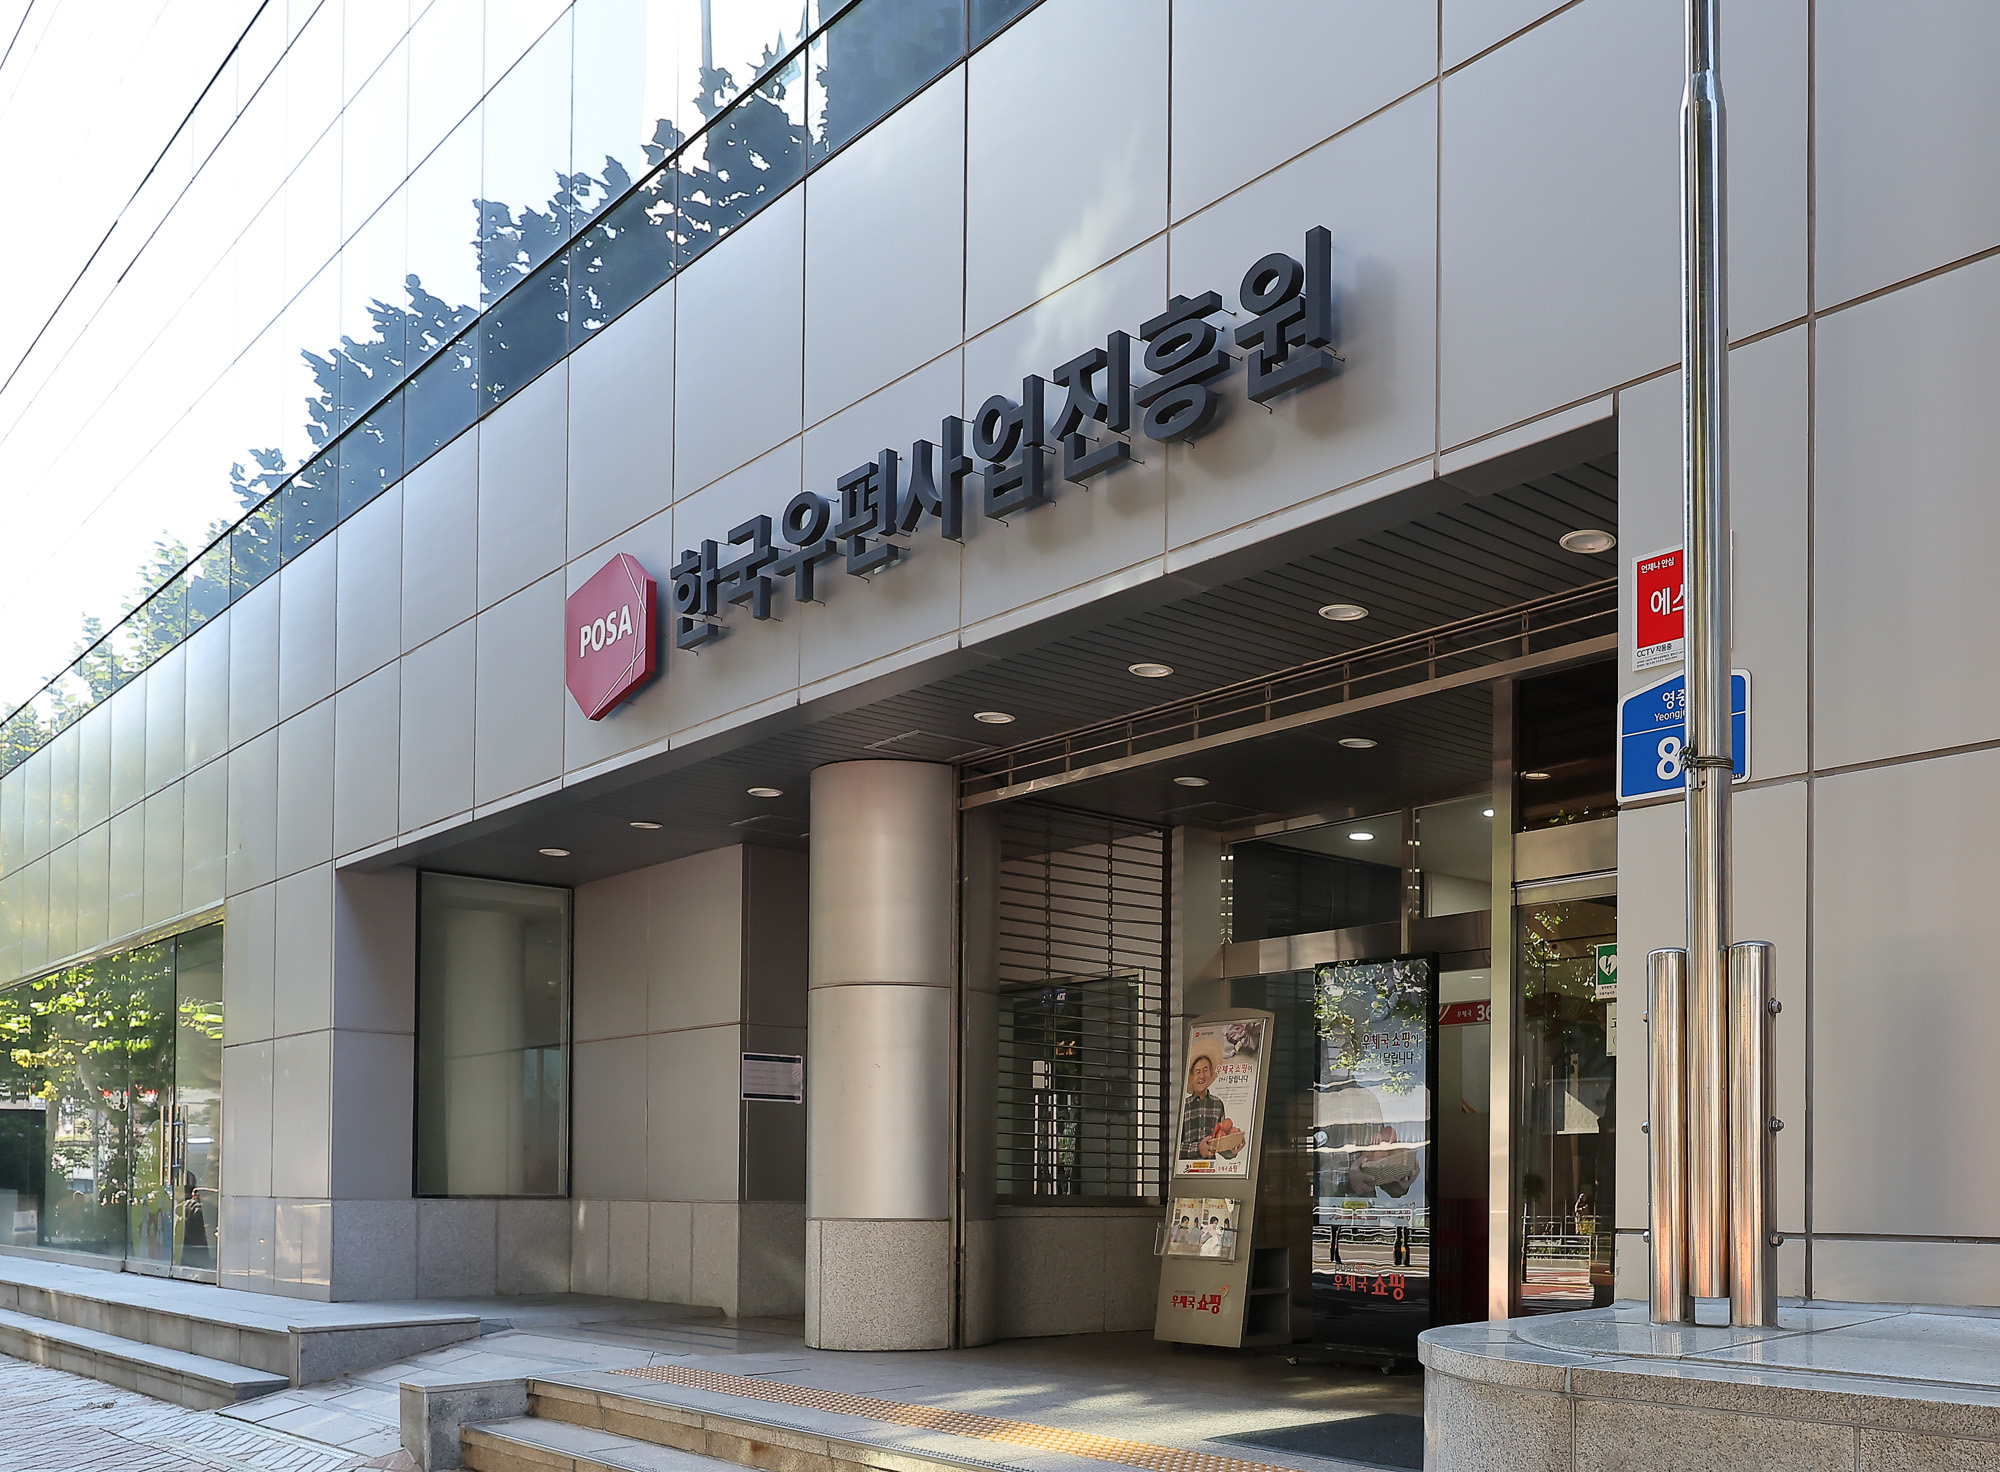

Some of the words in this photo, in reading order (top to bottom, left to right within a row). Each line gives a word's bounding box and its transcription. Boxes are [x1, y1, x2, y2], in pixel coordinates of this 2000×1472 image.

[670, 225, 1334, 650] 한국우편사업진흥원
[1640, 562, 1660, 574] 언제나
[1661, 556, 1675, 569] 안심
[579, 604, 633, 658] POSA
[1636, 647, 1656, 658] CCTV
[1362, 1033, 1389, 1049] 우체국
[1391, 1031, 1419, 1048] 쇼핑이
[1383, 1050, 1414, 1066] 달립니다
[1216, 1065, 1234, 1074] 우체국
[1235, 1064, 1253, 1073] 쇼핑이
[1333, 1274, 1368, 1292] 우체국
[1371, 1273, 1405, 1300] 쇼핑
[1171, 1294, 1196, 1309] 우체국
[1196, 1294, 1222, 1315] 쇼핑
